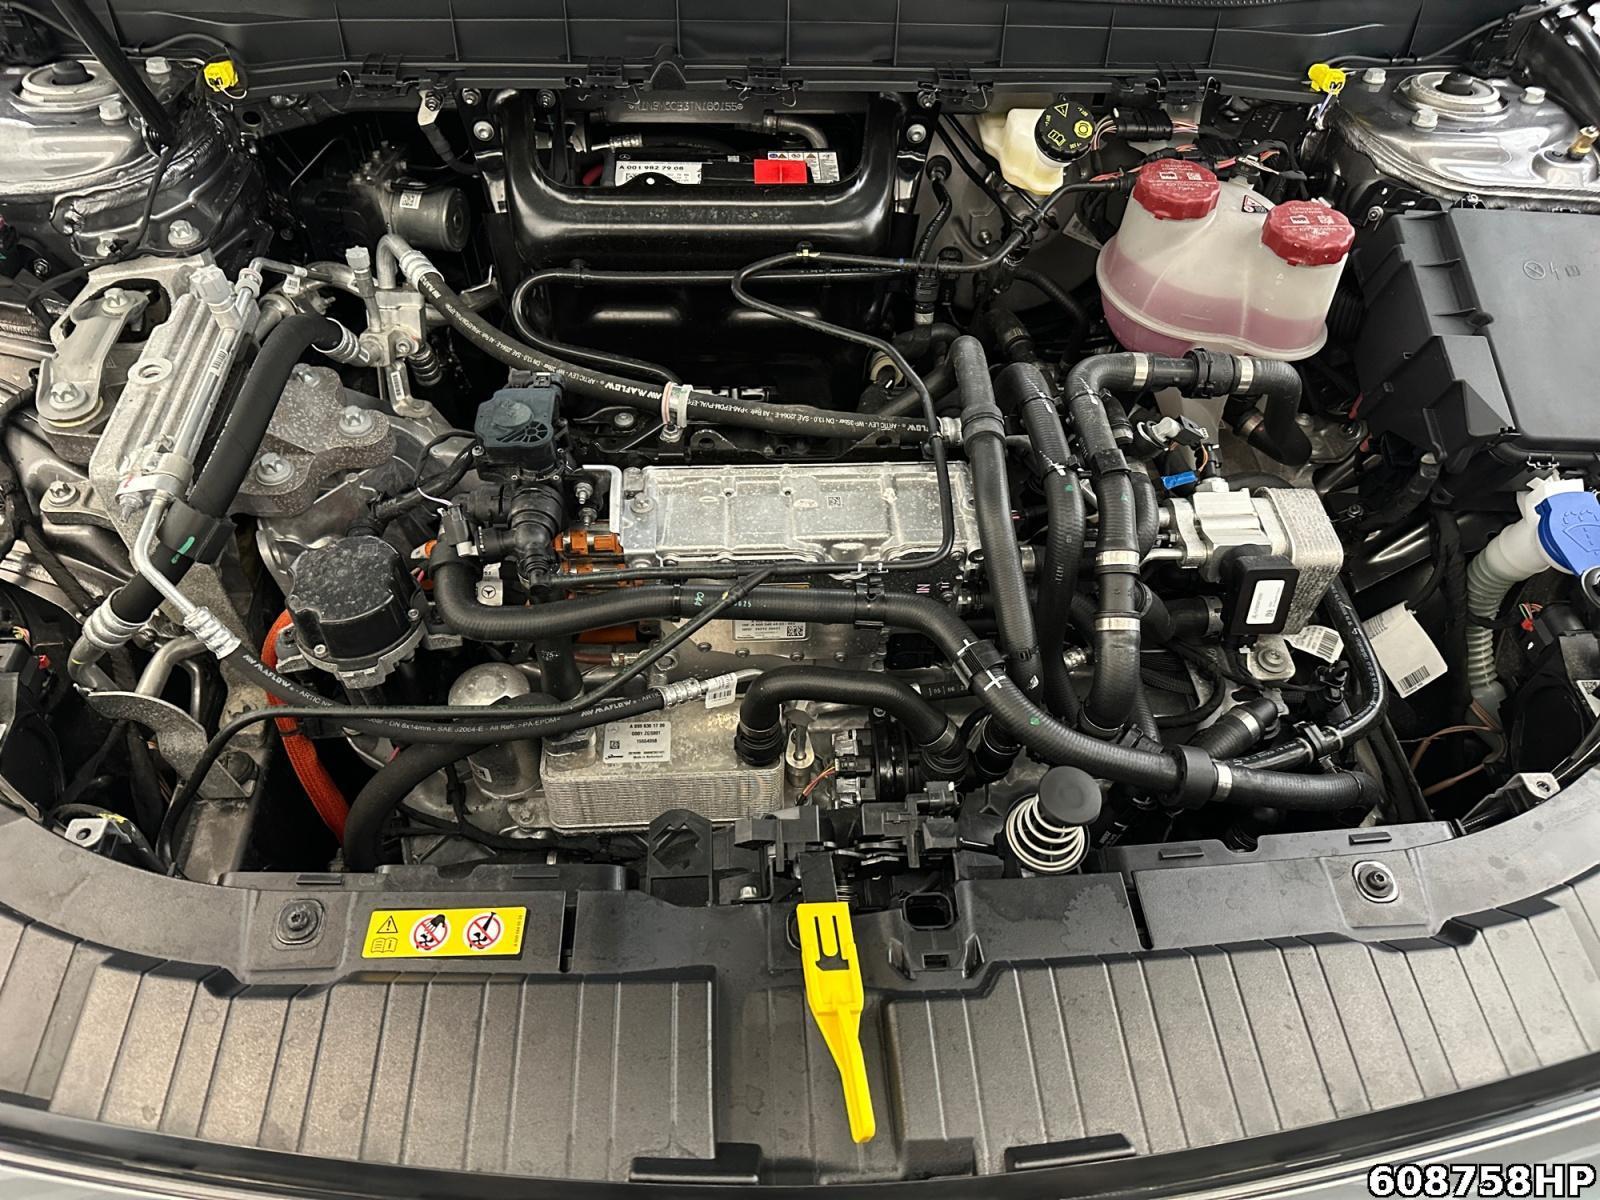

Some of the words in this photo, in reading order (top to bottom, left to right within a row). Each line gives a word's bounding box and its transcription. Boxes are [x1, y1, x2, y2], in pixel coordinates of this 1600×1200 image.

[605, 382, 648, 397] MAFLOW
[254, 662, 292, 688] MAFLOW
[300, 690, 321, 704] ARTIC
[595, 700, 632, 714] MAFLOW
